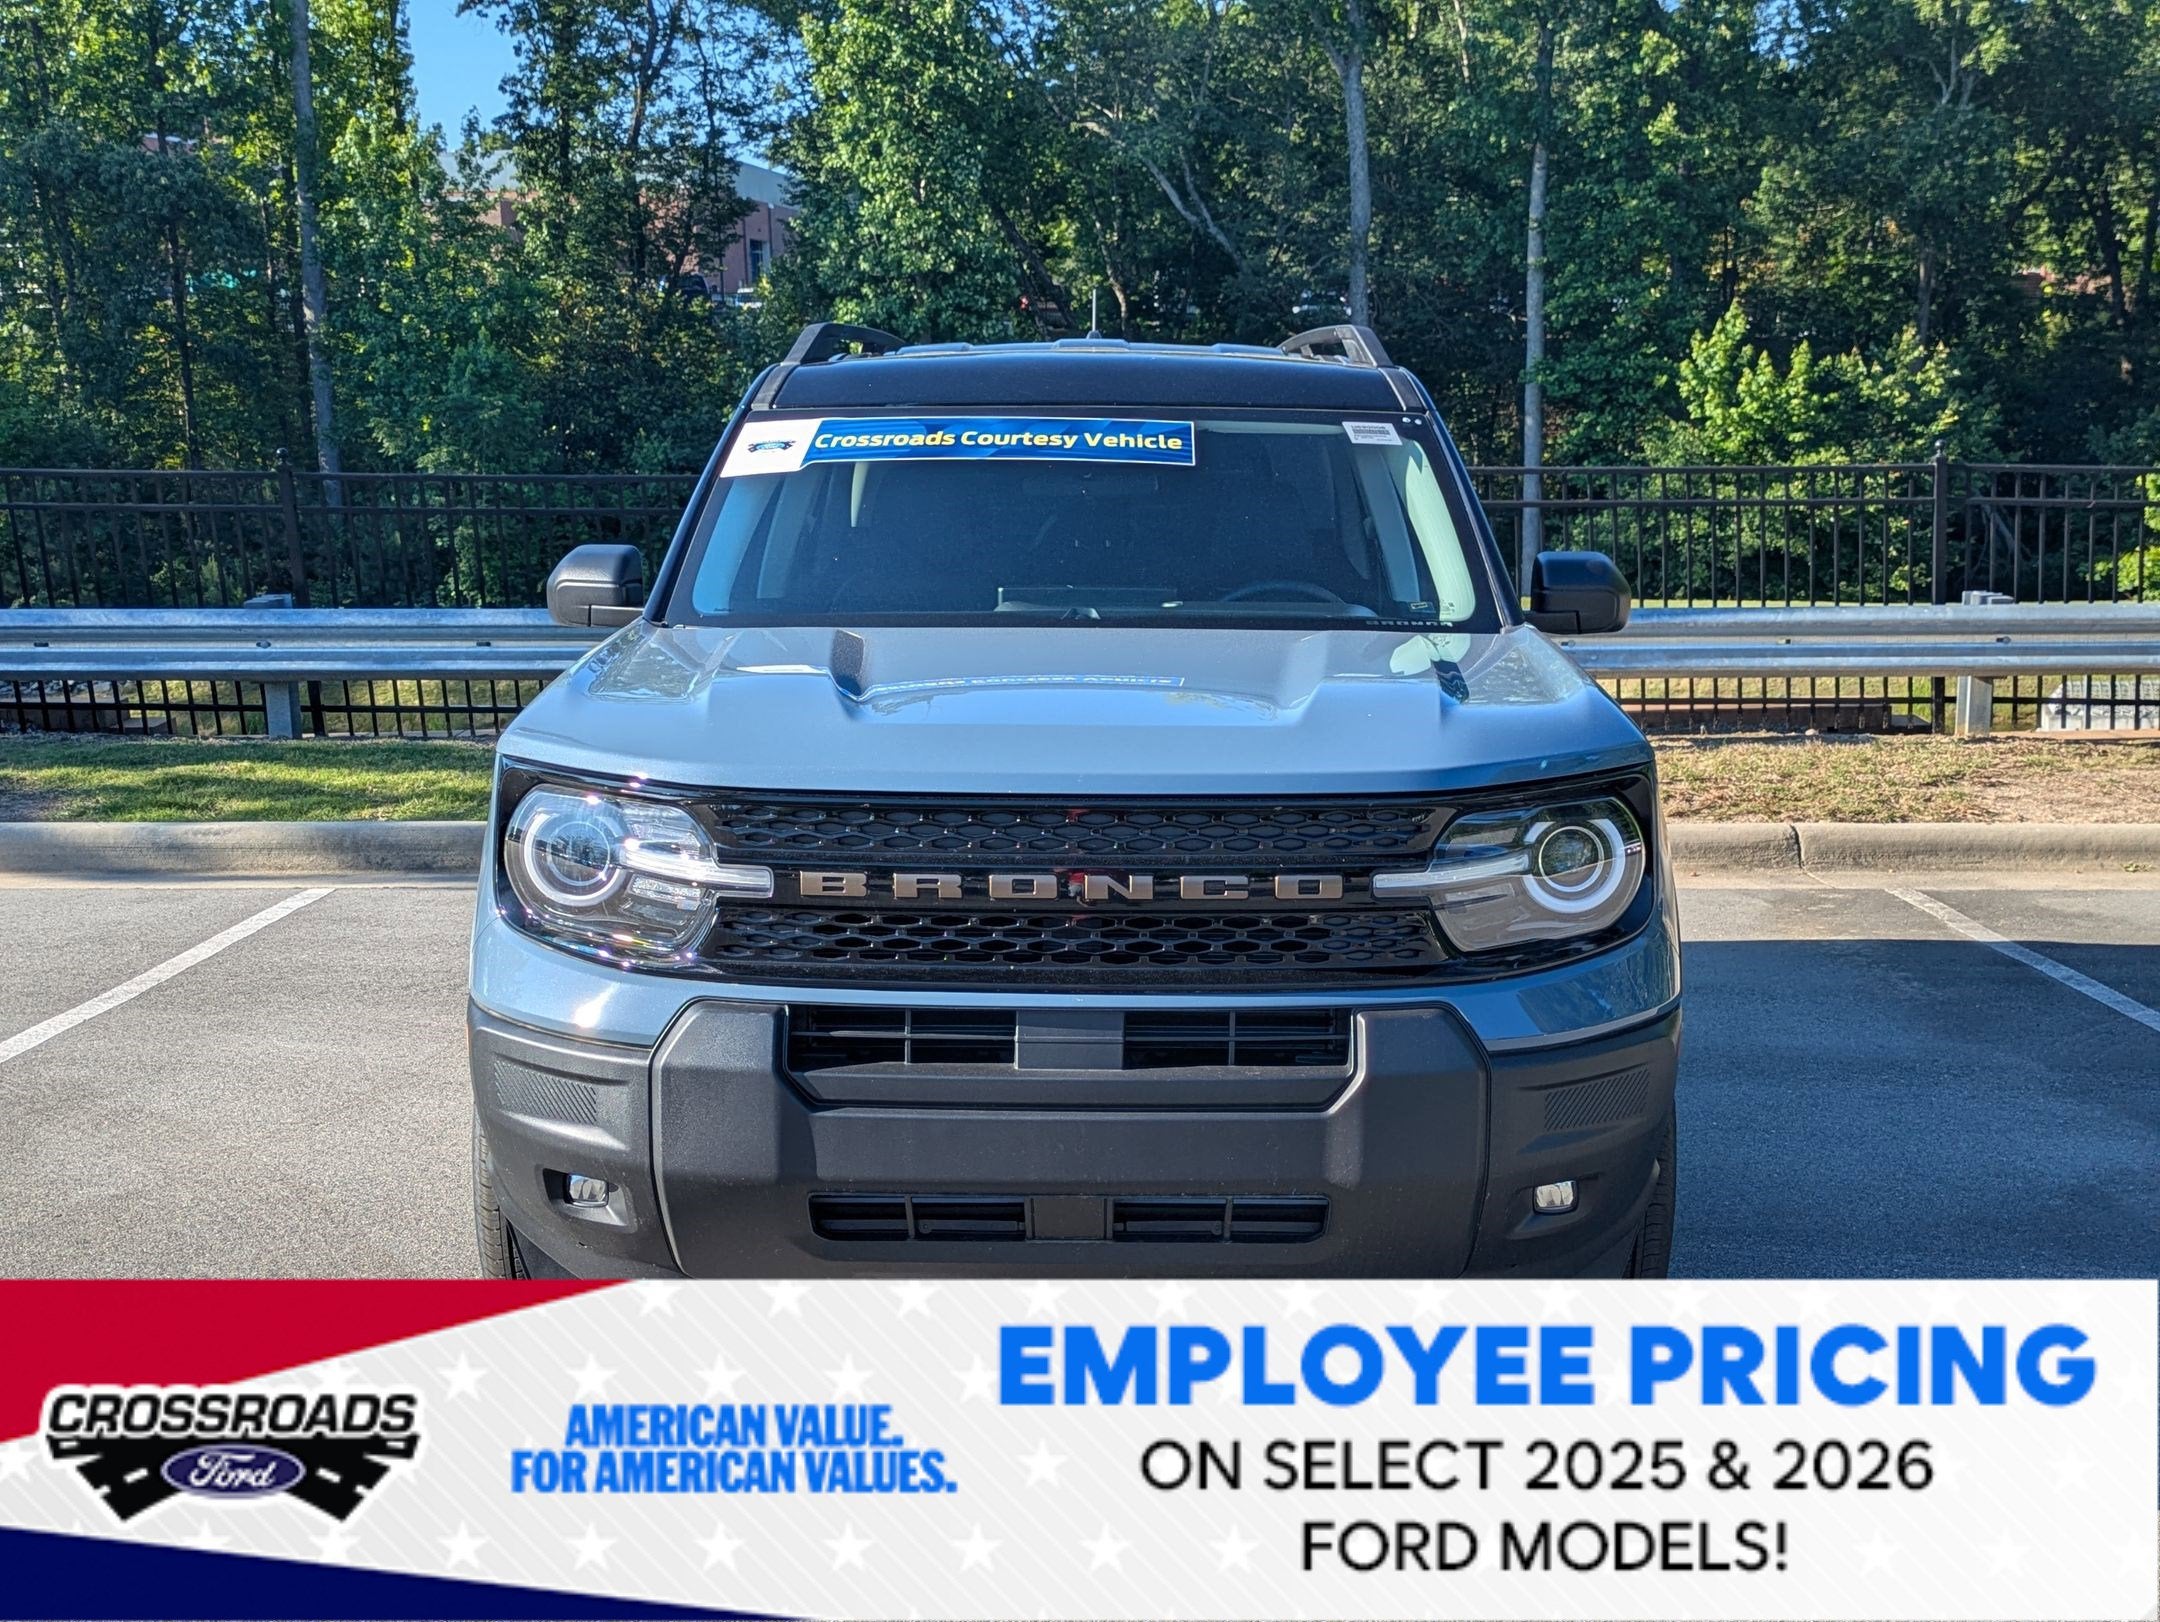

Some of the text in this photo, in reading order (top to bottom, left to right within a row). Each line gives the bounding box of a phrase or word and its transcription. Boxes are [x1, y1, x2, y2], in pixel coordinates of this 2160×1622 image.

[814, 430, 1184, 451] Crossroads Courtesy Vehicle
[799, 871, 1344, 900] BRONCO
